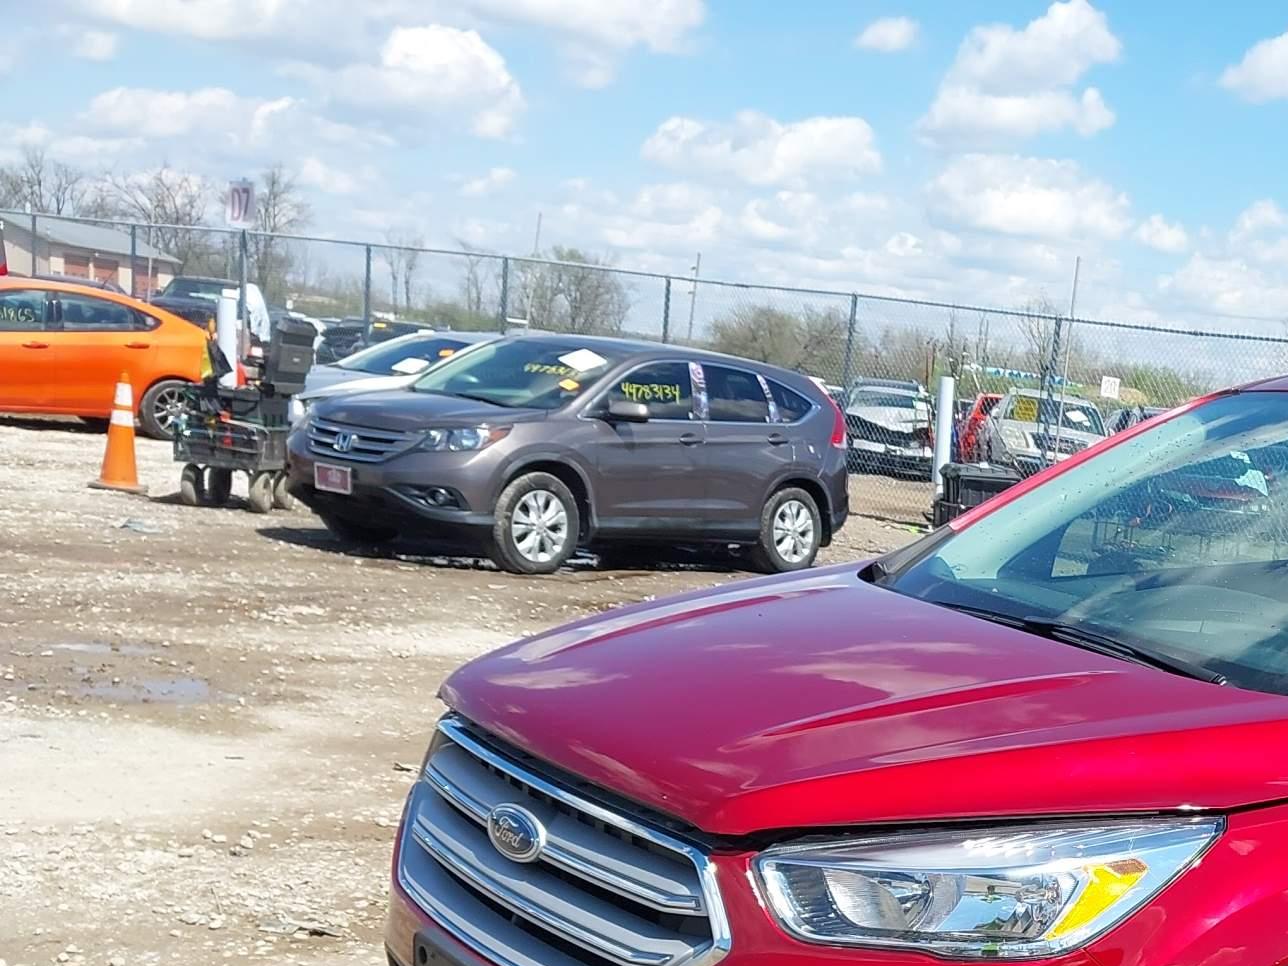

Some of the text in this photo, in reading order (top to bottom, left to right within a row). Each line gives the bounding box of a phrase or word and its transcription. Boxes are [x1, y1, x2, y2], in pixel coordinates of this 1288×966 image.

[231, 187, 250, 221] D7
[620, 382, 681, 404] 44783134
[494, 816, 525, 849] Ford
